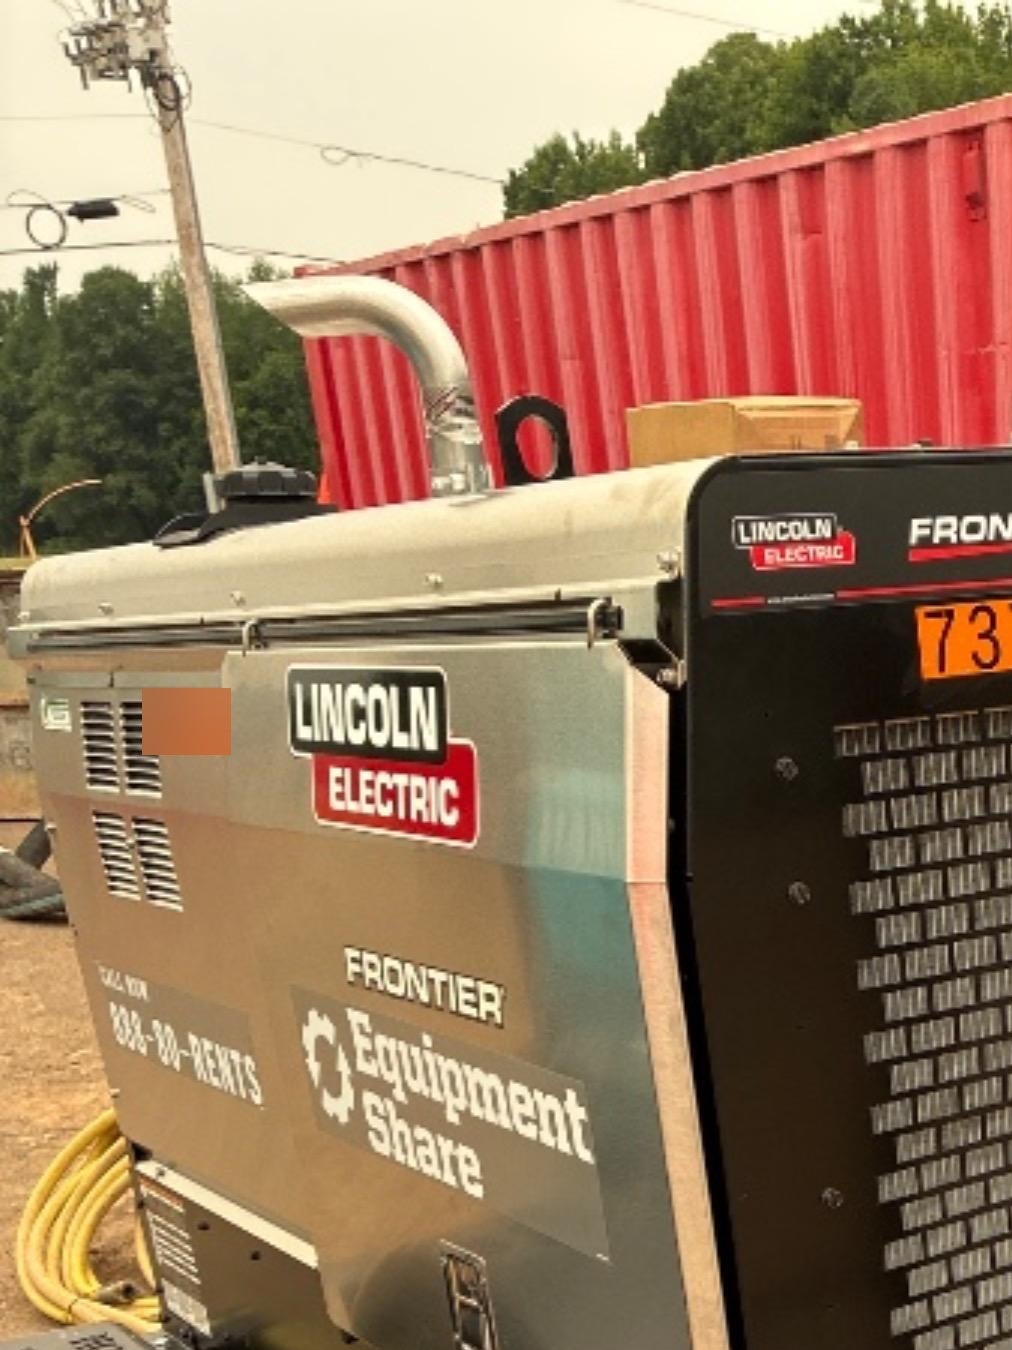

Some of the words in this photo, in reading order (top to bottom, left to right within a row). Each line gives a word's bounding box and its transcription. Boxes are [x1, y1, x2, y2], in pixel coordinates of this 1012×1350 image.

[738, 517, 832, 544] LINCOLN
[763, 544, 844, 565] ELECTRIC
[295, 682, 439, 751] LINCOLN
[329, 766, 460, 827] ELECTRIC
[344, 946, 504, 1028] FRONTIER
[345, 1007, 595, 1165] Equipment
[362, 1089, 484, 1200] Share
